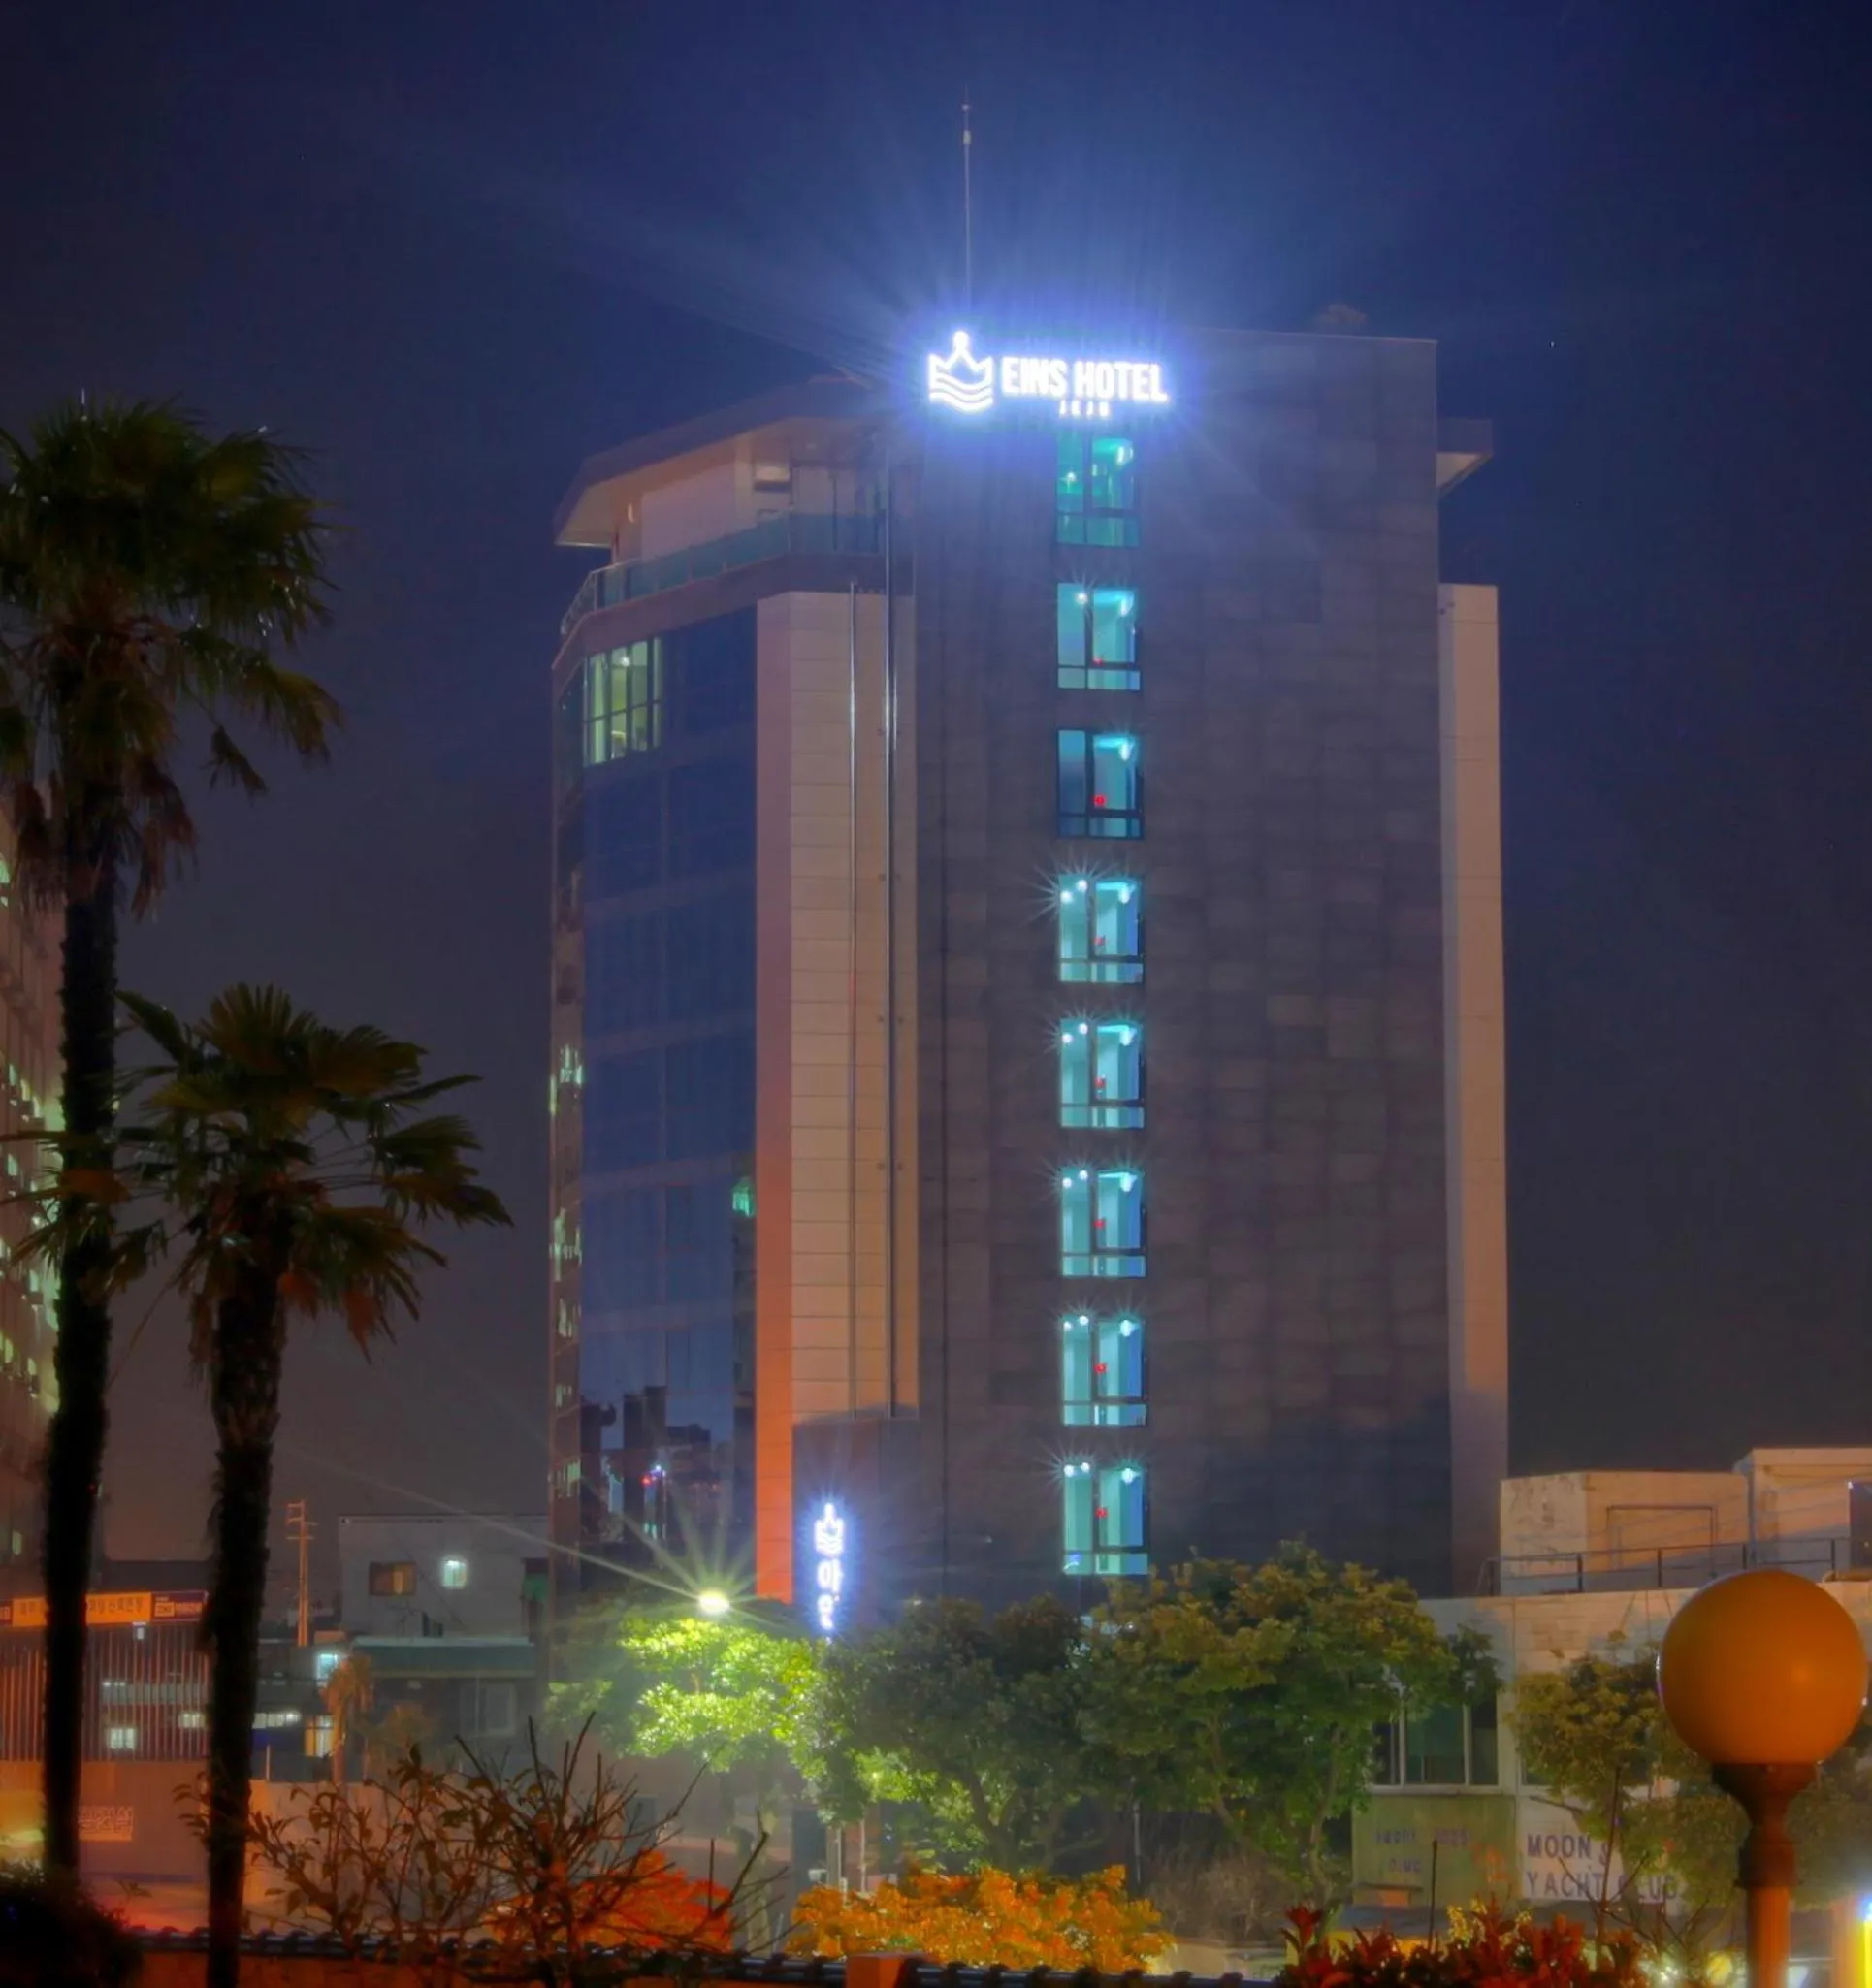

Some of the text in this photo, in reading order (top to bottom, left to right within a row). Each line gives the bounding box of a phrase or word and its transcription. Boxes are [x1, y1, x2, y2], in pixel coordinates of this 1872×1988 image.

[1002, 356, 1168, 402] EINS HOTEL
[1527, 1834, 1591, 1859] MOON
[1527, 1871, 1677, 1899] YACHT CUB
